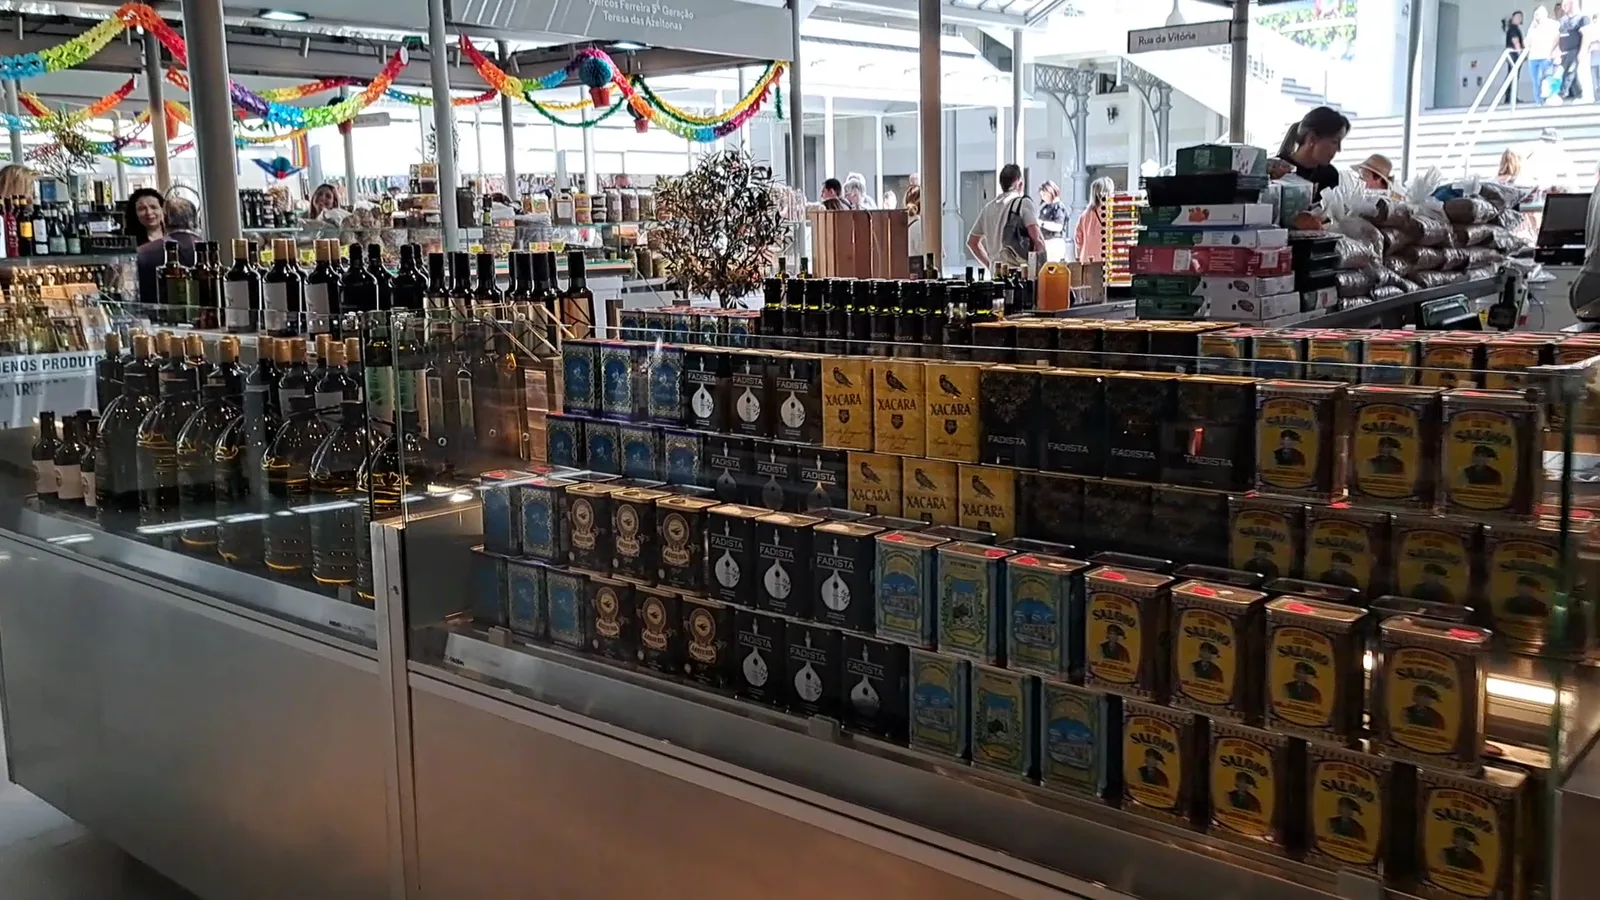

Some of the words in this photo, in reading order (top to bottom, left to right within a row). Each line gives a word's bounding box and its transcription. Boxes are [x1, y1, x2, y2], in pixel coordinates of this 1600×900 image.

[620, 1, 651, 14] Ferreira
[662, 5, 694, 20] Geração
[603, 10, 629, 23] Teresa
[631, 17, 645, 26] das
[646, 16, 682, 31] Azeitonas
[1138, 36, 1154, 46] Rua
[1155, 35, 1166, 44] da
[1167, 32, 1196, 43] Vitória
[0, 360, 37, 373] ENOS
[687, 372, 717, 383] FADISTA
[732, 375, 763, 386] FADISTA
[776, 380, 808, 391] FADISTA
[825, 393, 862, 406] XACARA
[877, 398, 917, 411] XACARA
[930, 403, 972, 416] XACARA
[987, 434, 1026, 446] FADISTA
[1047, 442, 1089, 454] FADISTA
[1111, 448, 1156, 460] FADISTA
[711, 457, 741, 469] FADISTA
[757, 464, 788, 475] FADISTA
[801, 470, 837, 482] FADISTA
[852, 488, 891, 502] XACARA
[906, 495, 947, 510] XACARA
[962, 503, 1005, 518] XACARA
[711, 536, 744, 549] FADISTA
[759, 546, 794, 559] FADISTA
[816, 556, 854, 570] FADISTA
[738, 633, 772, 649] FADISTA
[789, 647, 826, 662] FADISTA
[847, 661, 884, 677] FADISTA
